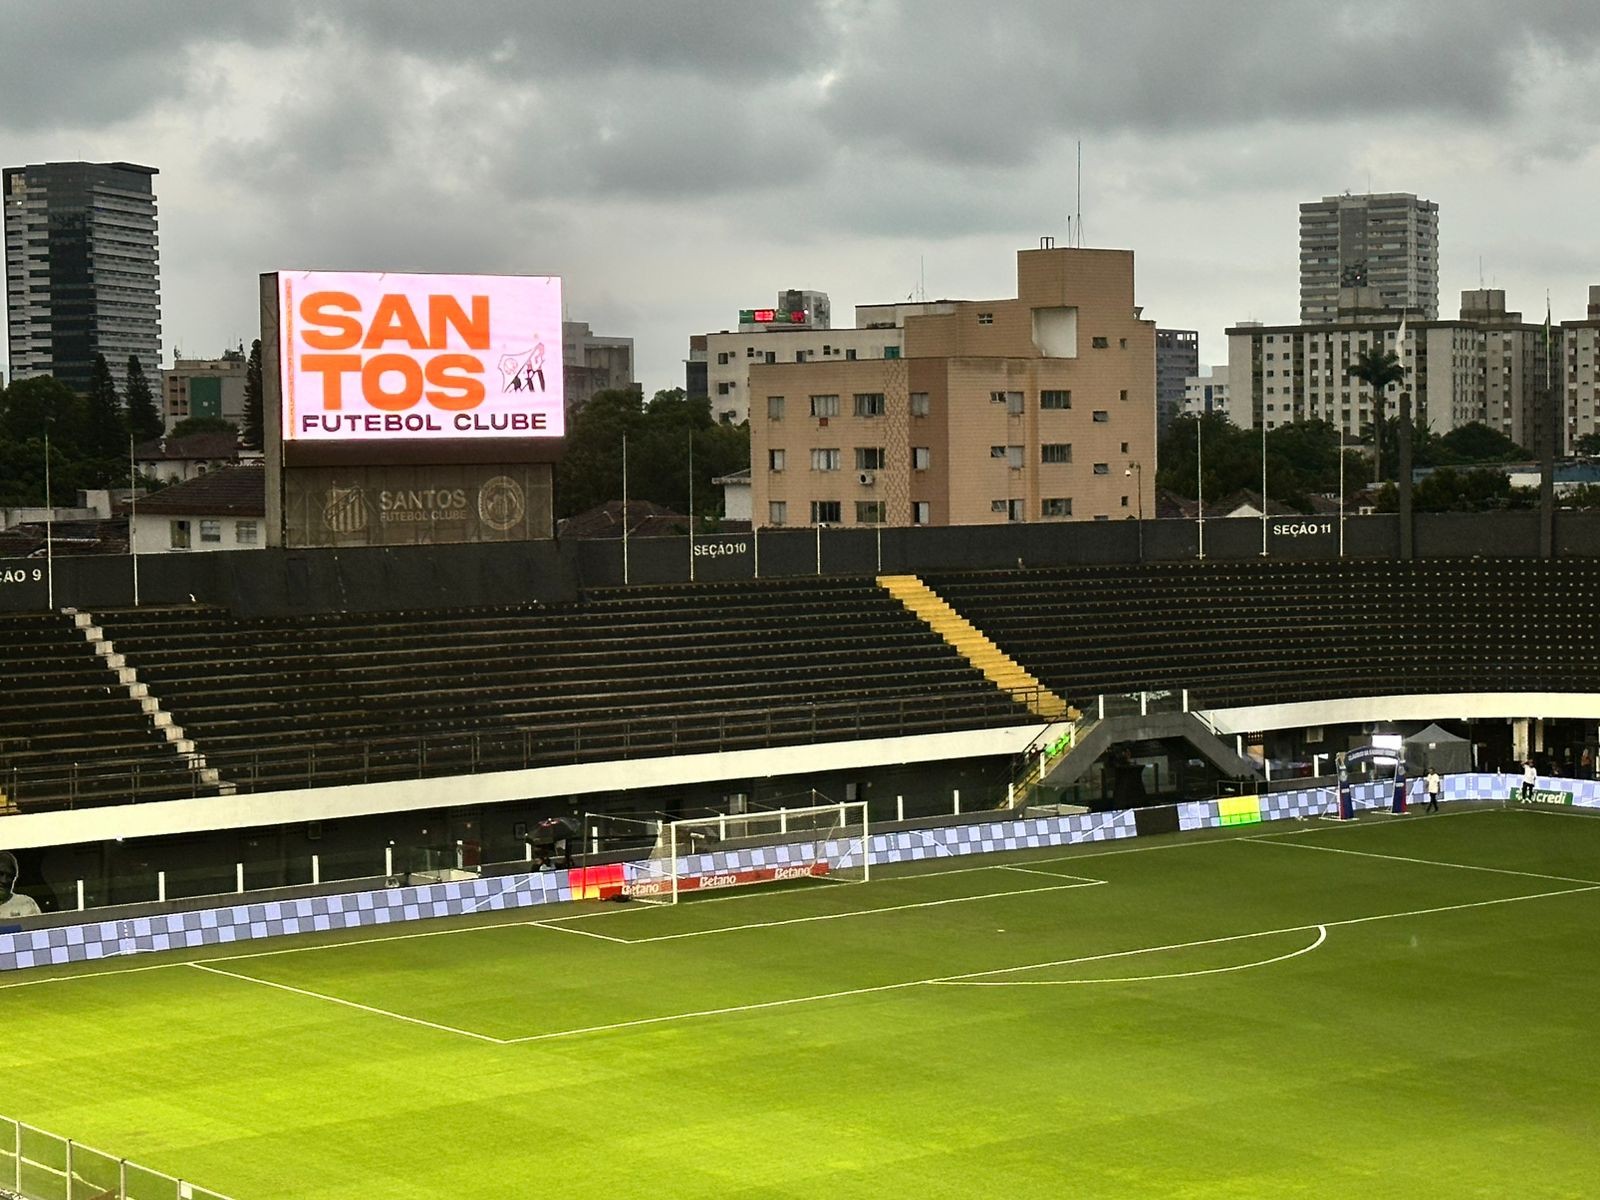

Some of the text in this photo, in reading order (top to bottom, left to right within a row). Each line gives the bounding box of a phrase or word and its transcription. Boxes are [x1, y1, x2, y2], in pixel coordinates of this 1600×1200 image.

[300, 291, 490, 350] SAN
[300, 353, 486, 411] TOS
[302, 413, 546, 432] FUTEBOL CLUBE
[379, 488, 467, 510] SANTOS
[380, 509, 467, 522] FUTEBOL CLUBE
[1273, 521, 1331, 538] SEÇÃO 11
[32, 568, 41, 581] 9
[700, 875, 736, 887] Betano
[775, 867, 810, 880] Betano
